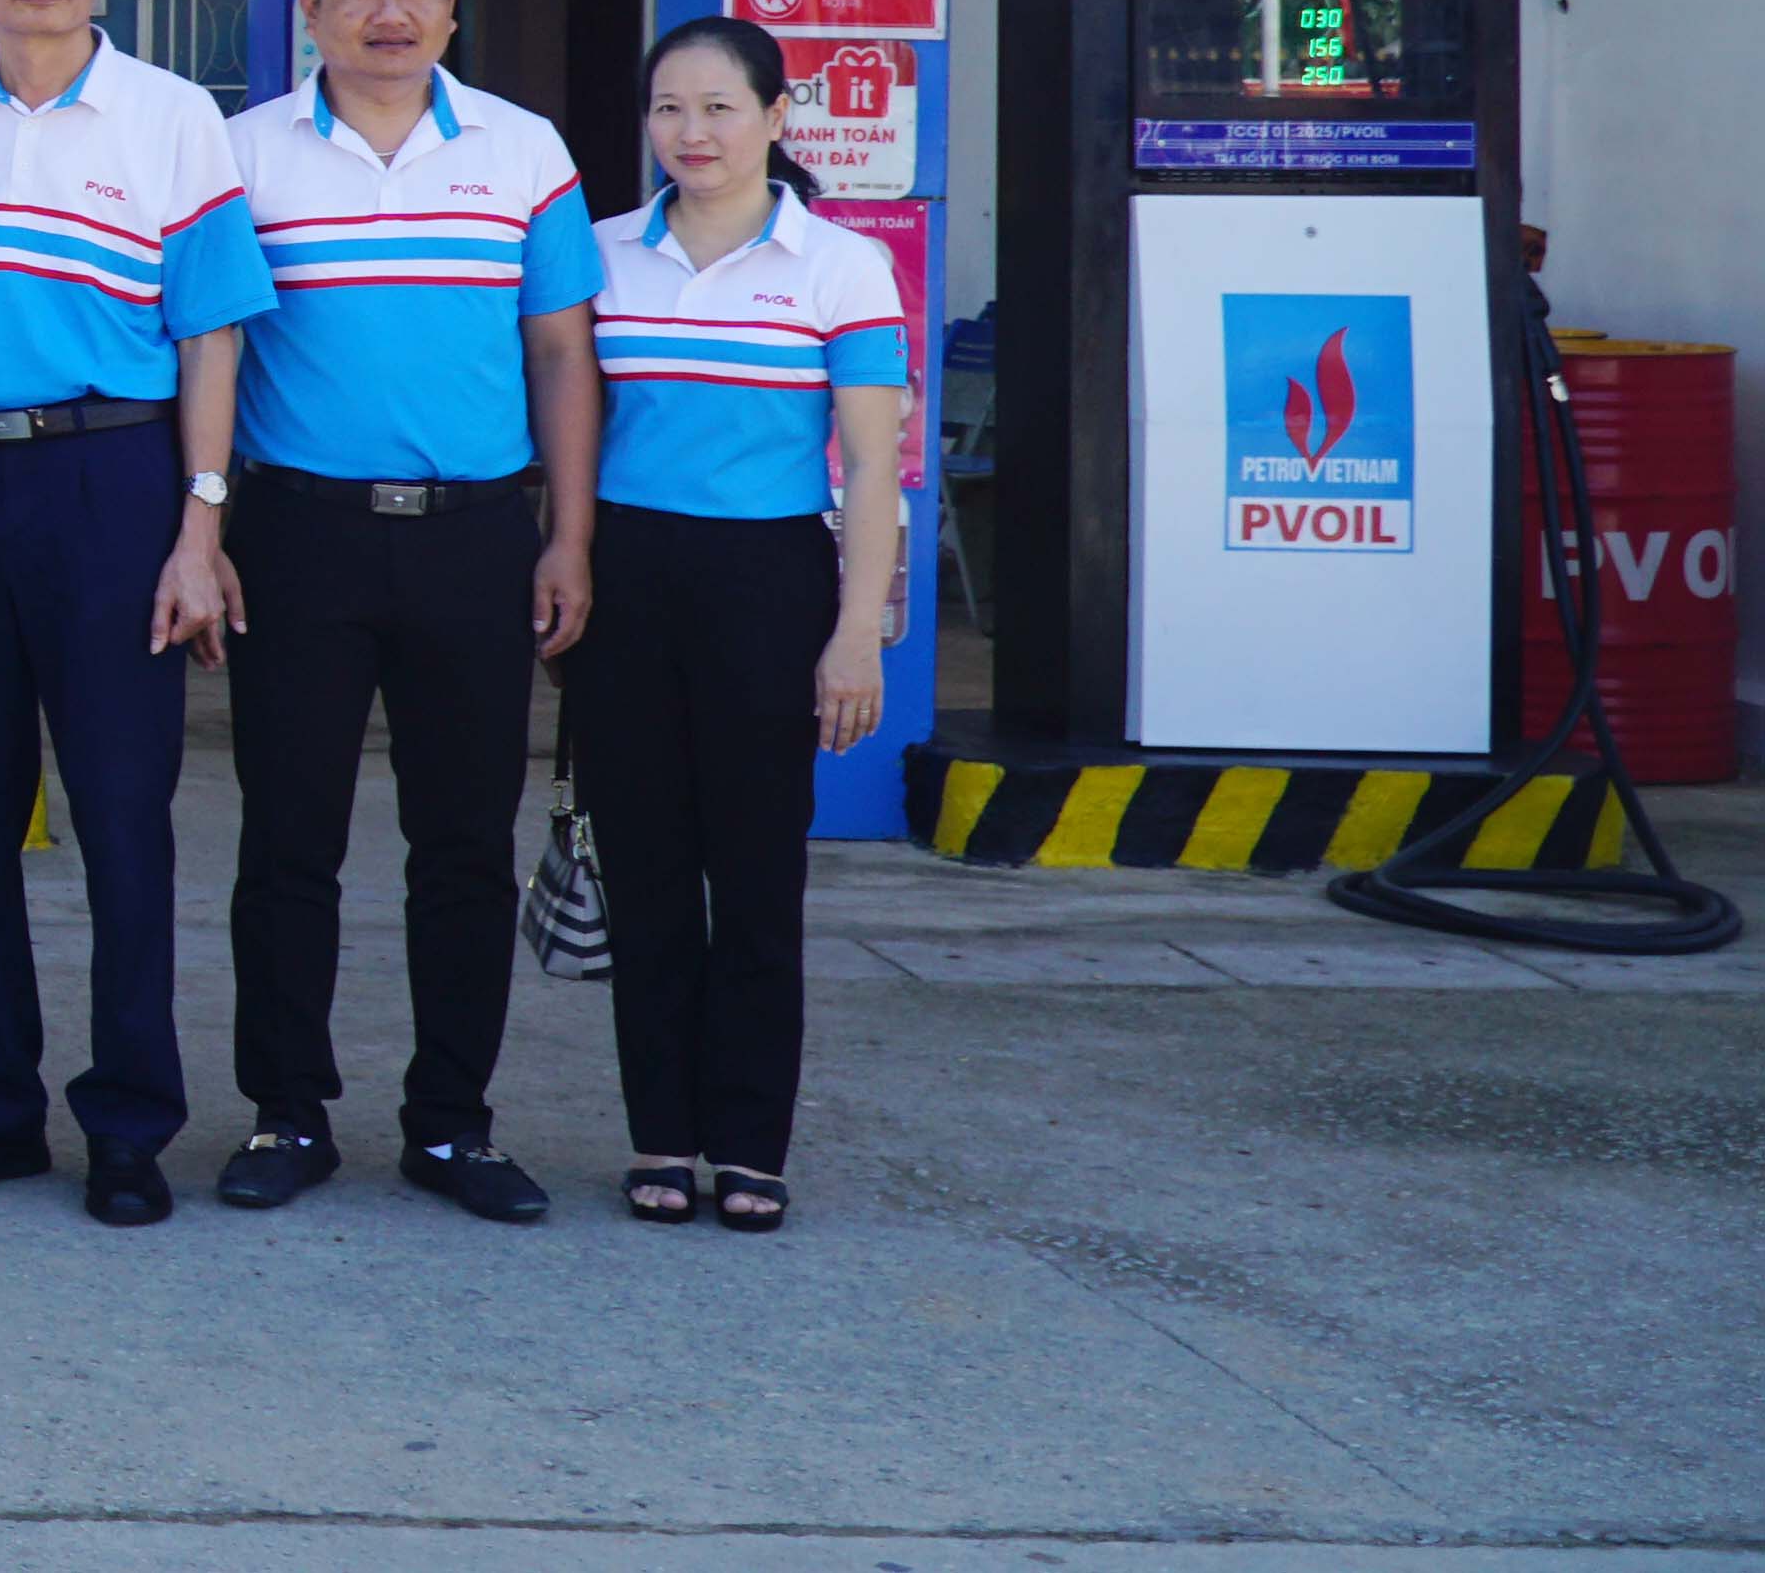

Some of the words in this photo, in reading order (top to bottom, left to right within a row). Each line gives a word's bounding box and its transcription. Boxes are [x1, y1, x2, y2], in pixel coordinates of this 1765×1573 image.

[850, 76, 874, 110] it
[842, 124, 896, 144] TOÁN
[794, 151, 822, 169] TẠI
[829, 148, 871, 166] ĐÂY
[85, 179, 127, 201] PVOIL
[449, 184, 495, 196] PVOIL
[878, 215, 915, 229] TOÁN
[753, 293, 798, 307] PVOIL
[1241, 456, 1399, 484] PETROVIETNAM
[1240, 503, 1397, 544] PVOIL
